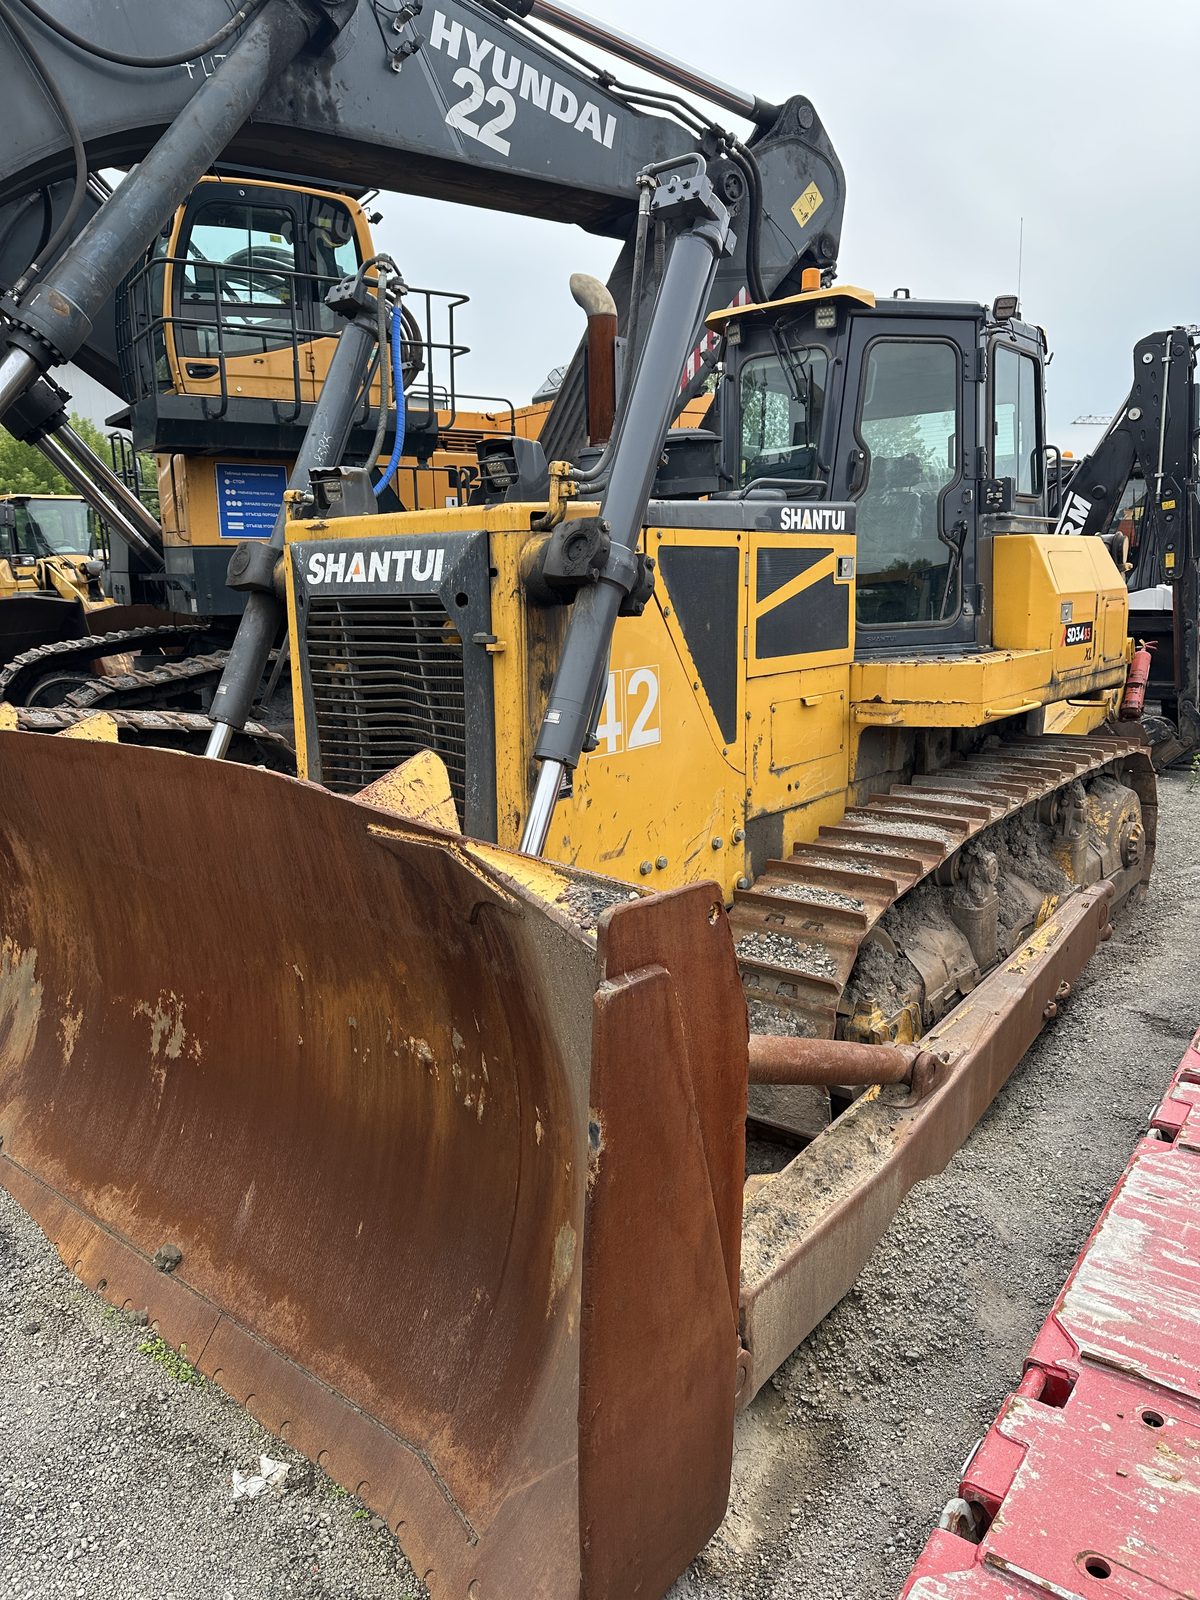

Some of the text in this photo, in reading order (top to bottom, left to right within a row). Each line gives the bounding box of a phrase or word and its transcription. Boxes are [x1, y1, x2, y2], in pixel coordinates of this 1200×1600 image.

[430, 10, 617, 149] HYUNDAI
[445, 67, 517, 156] 22
[780, 507, 846, 531] SHANTUI
[306, 549, 445, 585] SHANTUI
[595, 668, 660, 753] 42
